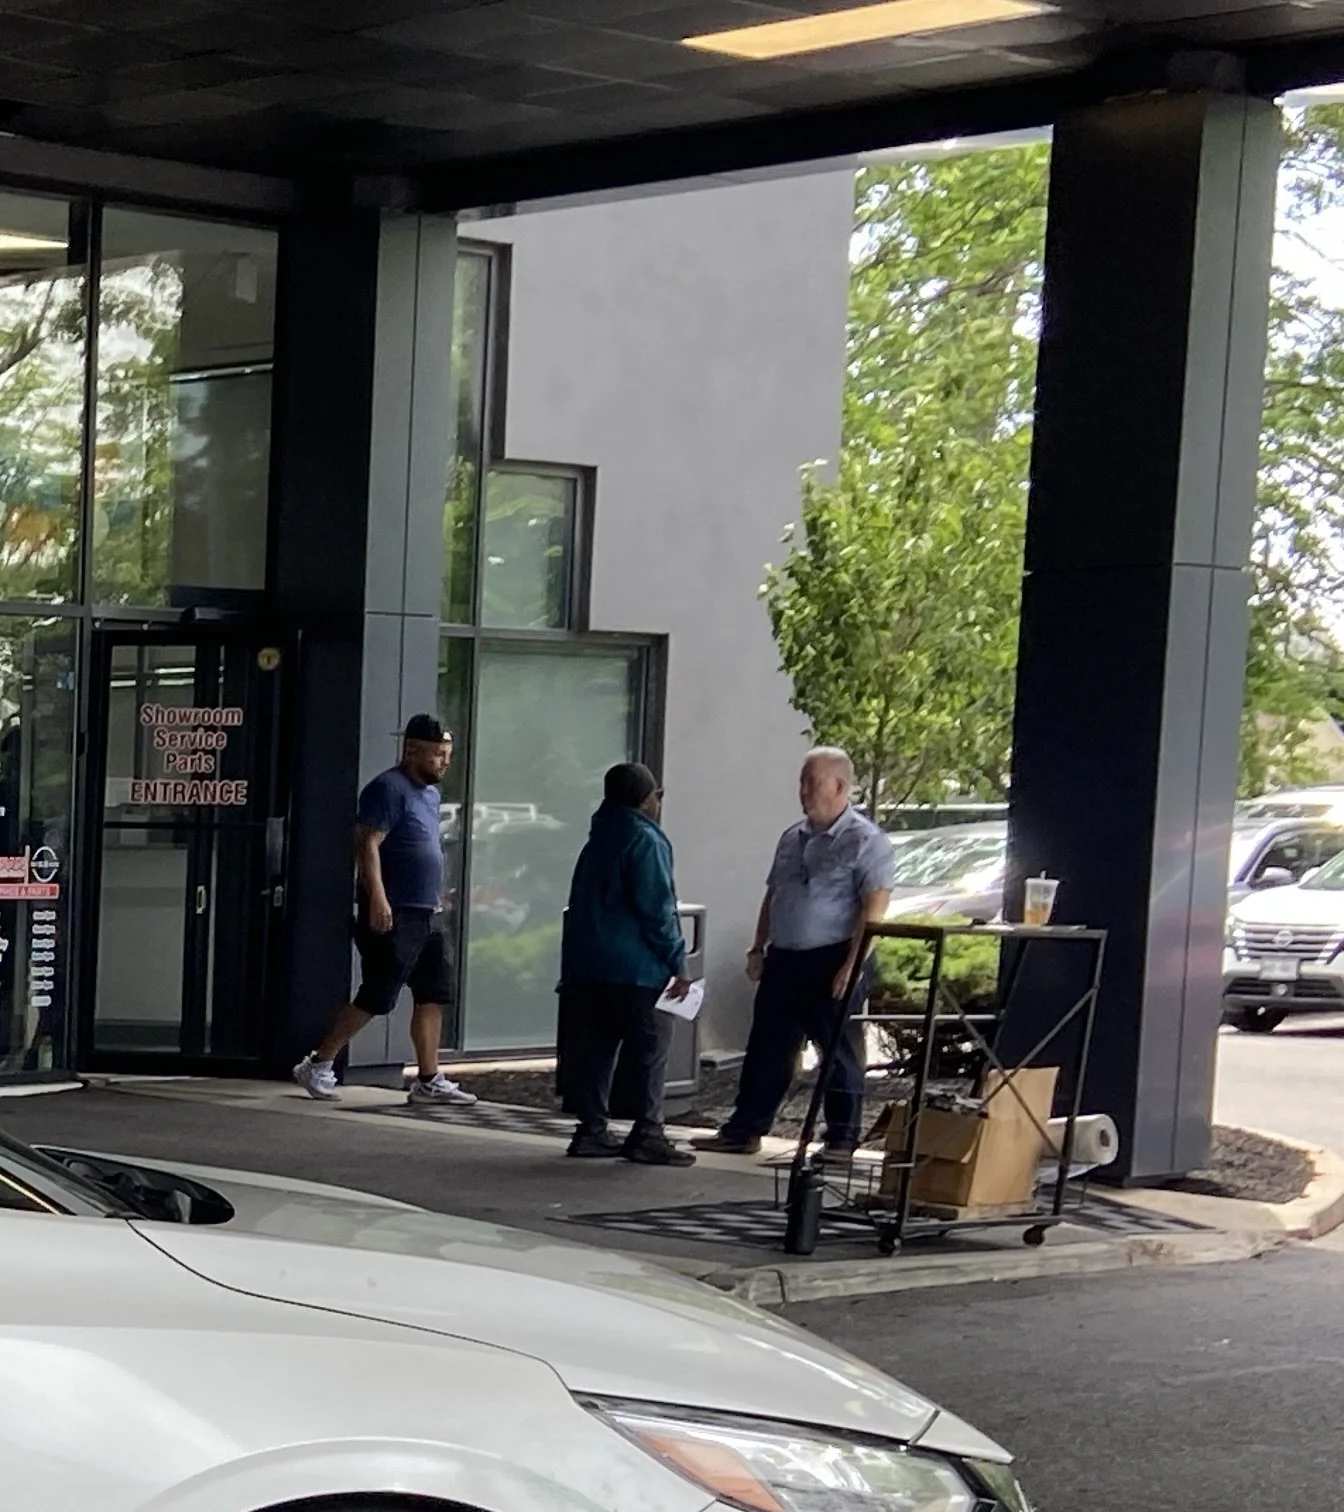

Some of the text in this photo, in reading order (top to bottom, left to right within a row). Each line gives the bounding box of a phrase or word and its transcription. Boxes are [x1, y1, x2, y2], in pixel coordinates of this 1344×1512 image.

[140, 703, 244, 726] Showroom
[154, 727, 228, 750] Service
[164, 751, 216, 774] Parts
[130, 779, 249, 806] ENTRANCE
